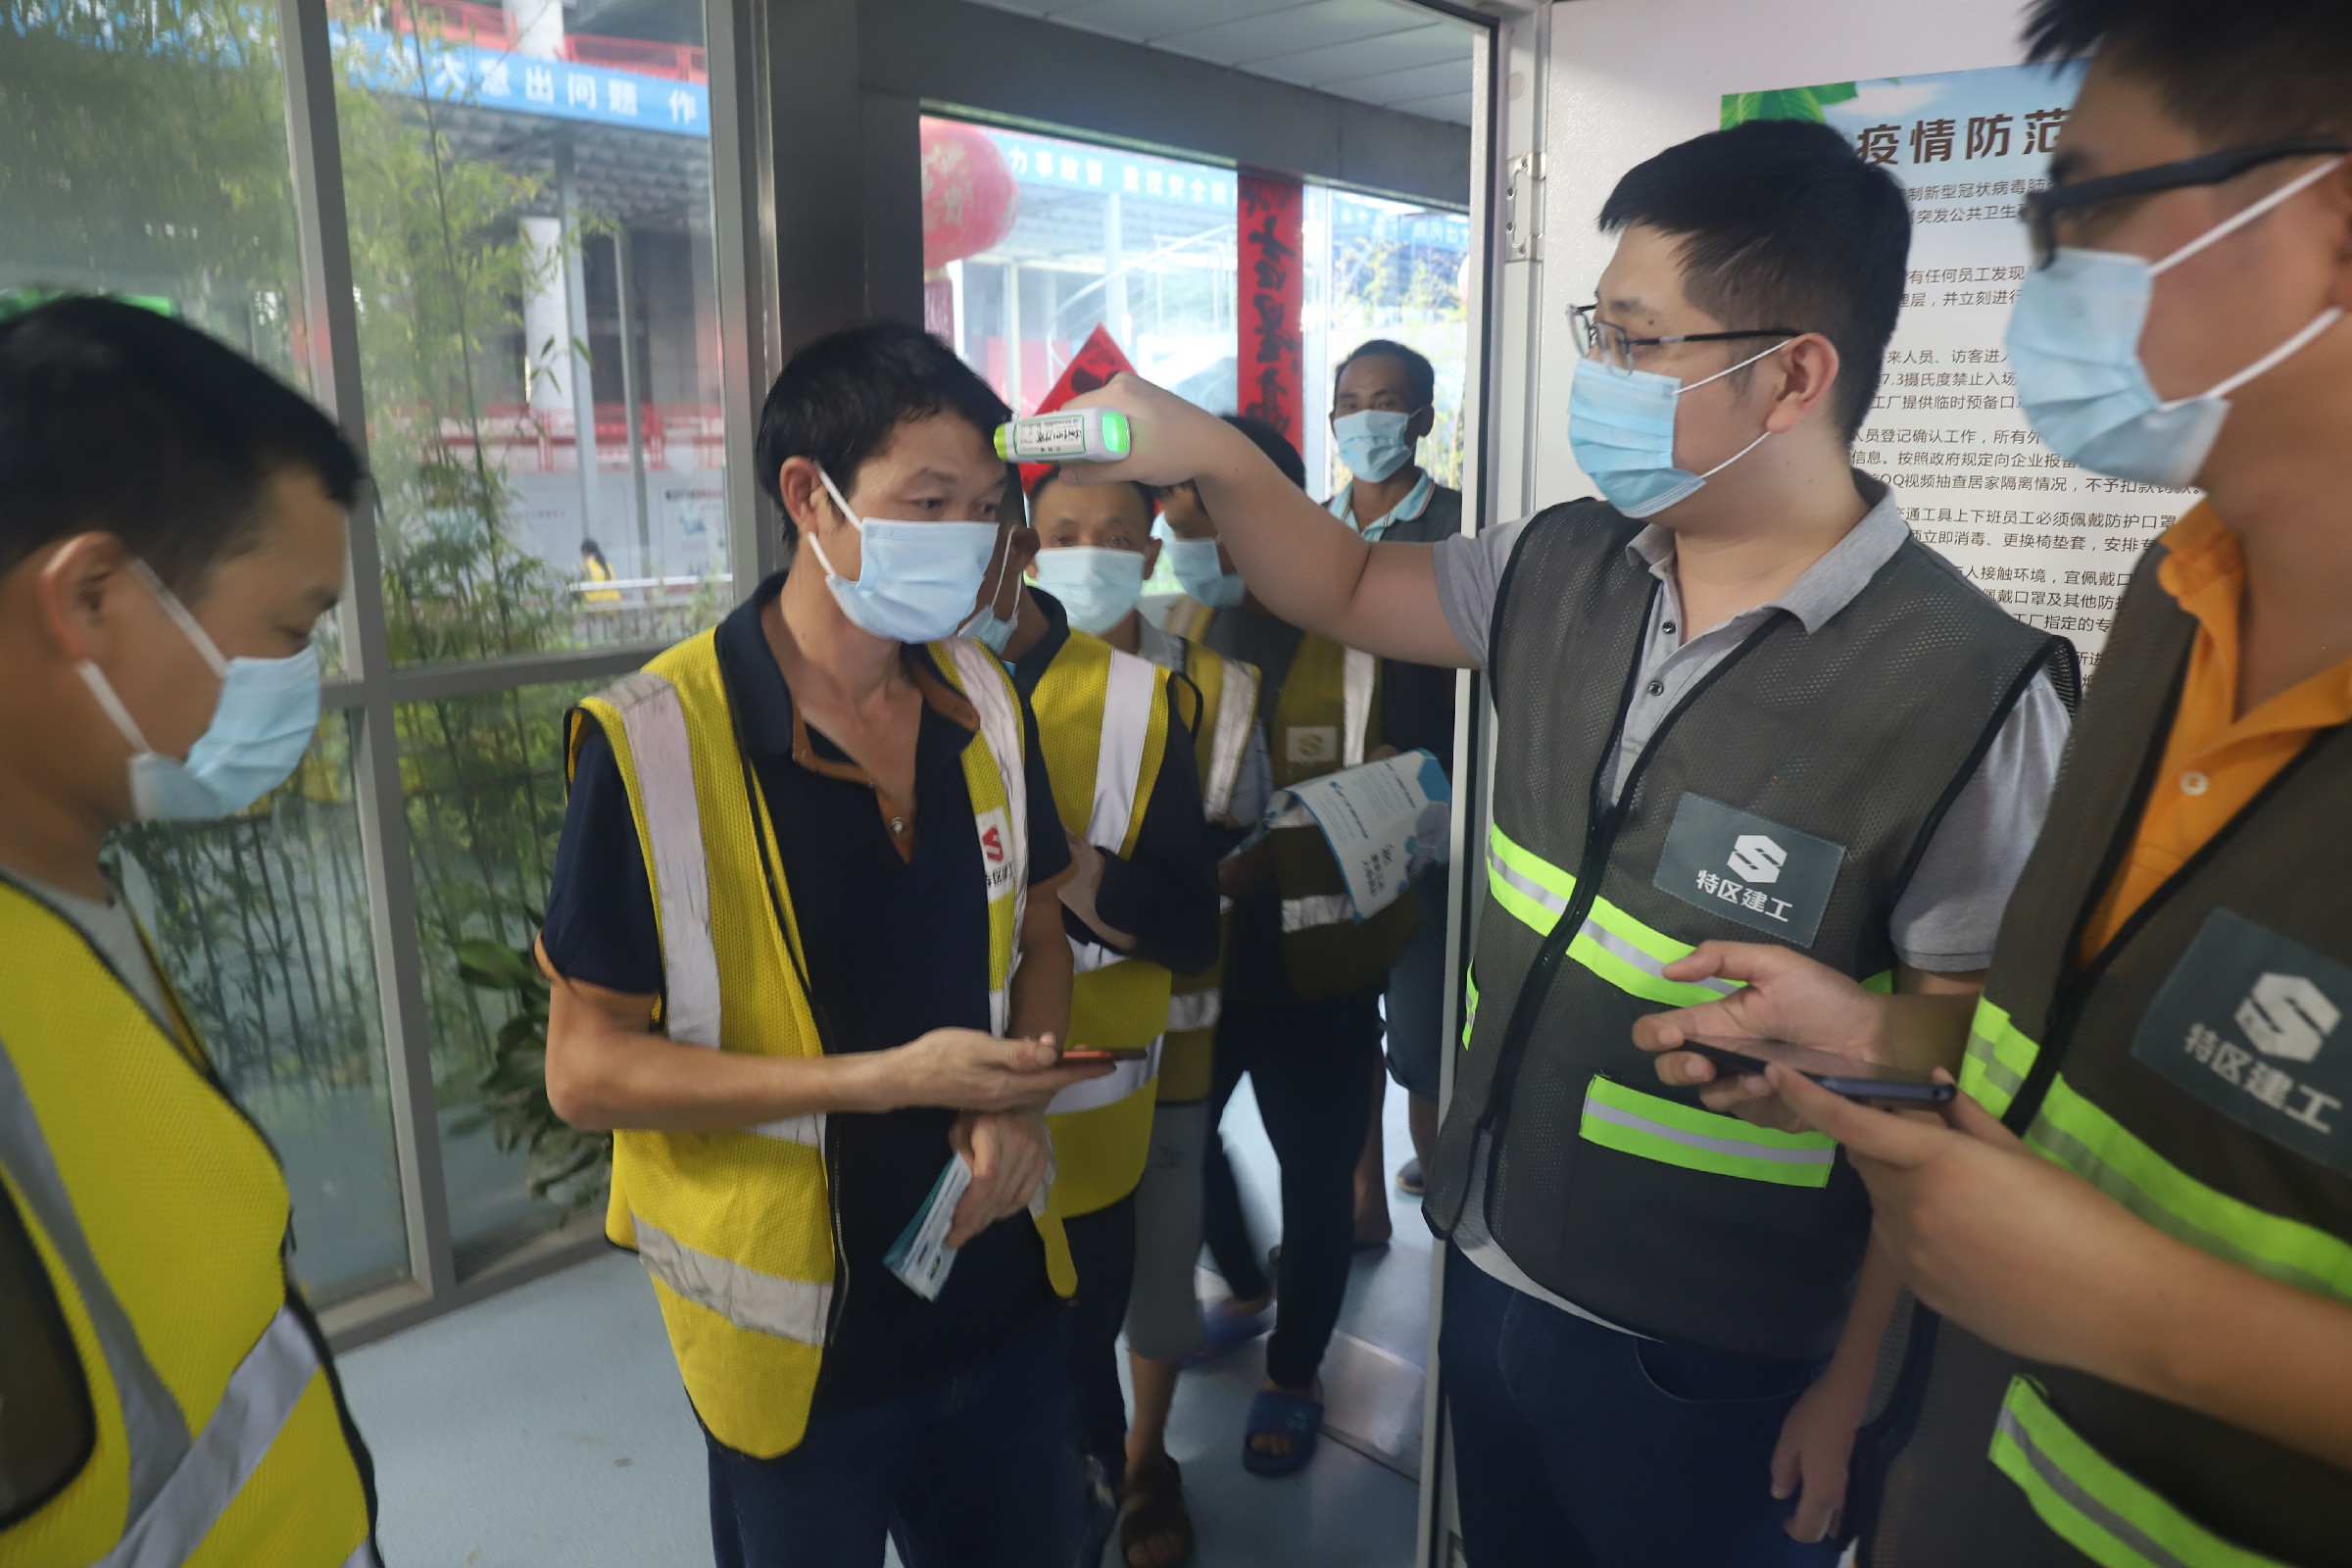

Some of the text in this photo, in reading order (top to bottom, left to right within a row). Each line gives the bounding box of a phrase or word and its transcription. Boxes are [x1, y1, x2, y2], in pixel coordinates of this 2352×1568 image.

[1856, 108, 2071, 165] 疫情防范
[1901, 177, 2053, 202] 制新型冠状病毒肺
[1884, 349, 2009, 365] 来人员、访客进
[1871, 395, 2026, 410] 工厂提供临时预备口
[1956, 565, 2132, 587] 人接触环境，宜佩戴口
[1695, 869, 1792, 923] 特区建工
[2183, 1022, 2342, 1134] 特区建工
